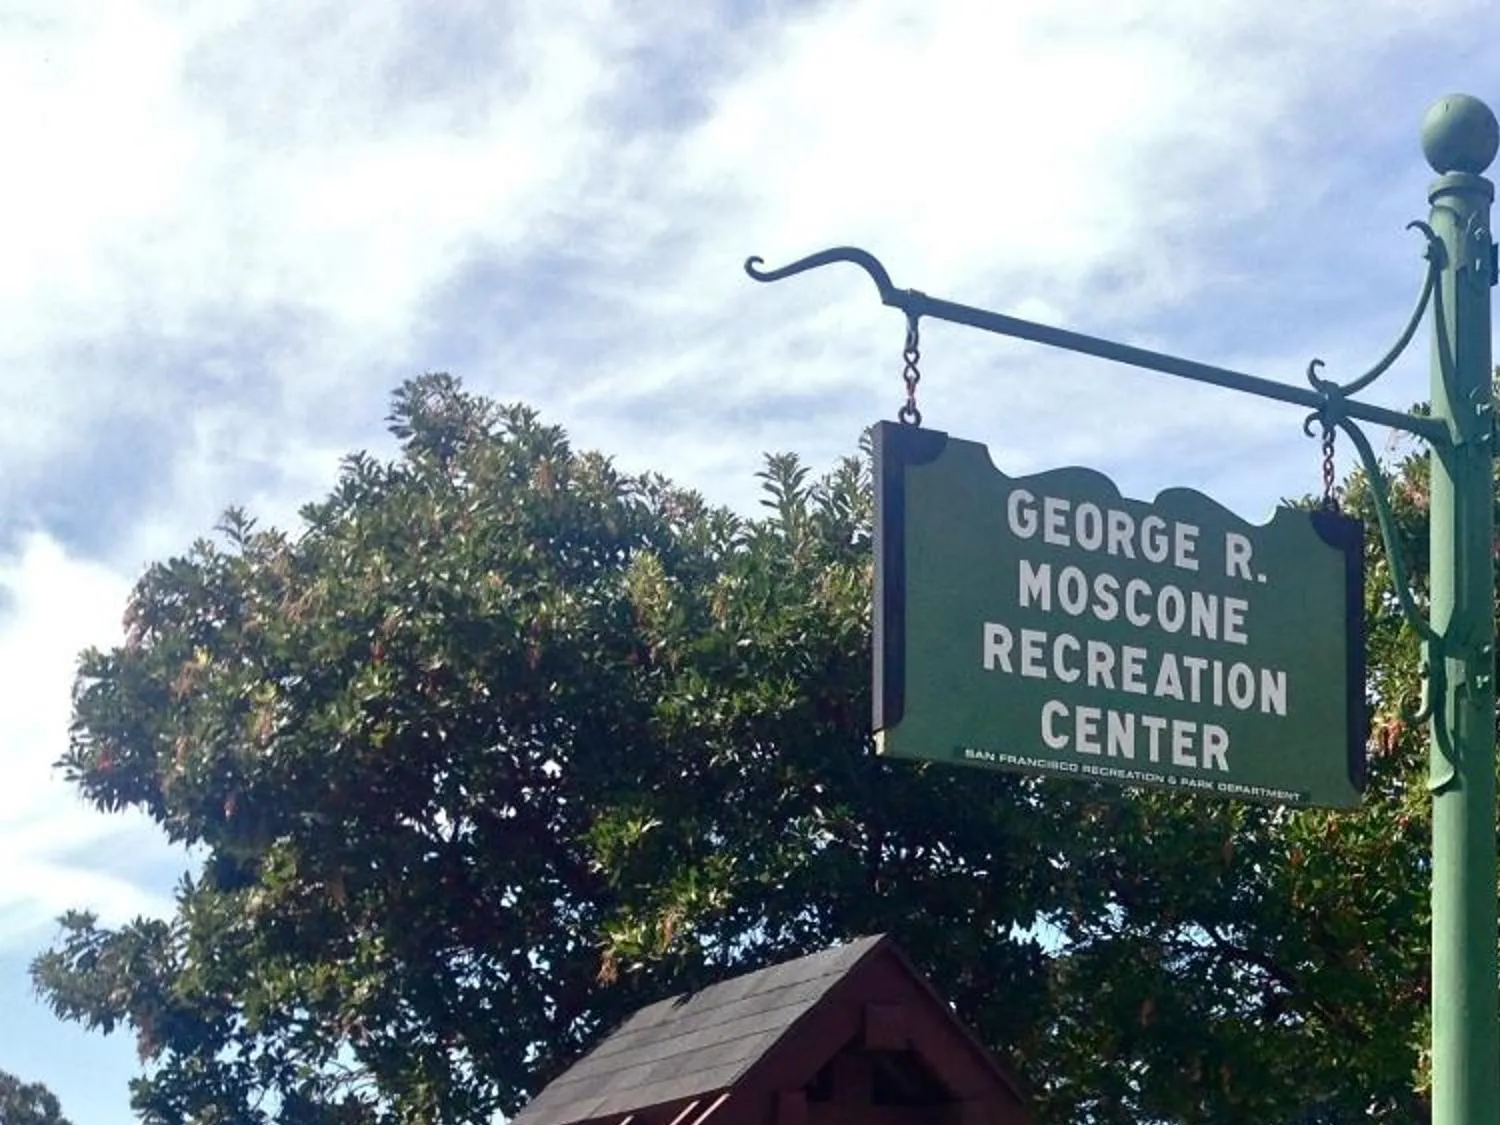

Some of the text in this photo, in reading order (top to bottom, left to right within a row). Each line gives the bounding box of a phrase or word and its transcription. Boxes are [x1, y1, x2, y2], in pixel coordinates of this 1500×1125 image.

[1007, 489, 1267, 583] GEORGE R.
[1019, 559, 1248, 645] MOSCONE
[983, 622, 1288, 716] RECREATION
[965, 748, 1300, 800] SAN FRANCISCO RECREATION & PARK DEPARTMENT
[1041, 700, 1230, 771] CENTER
